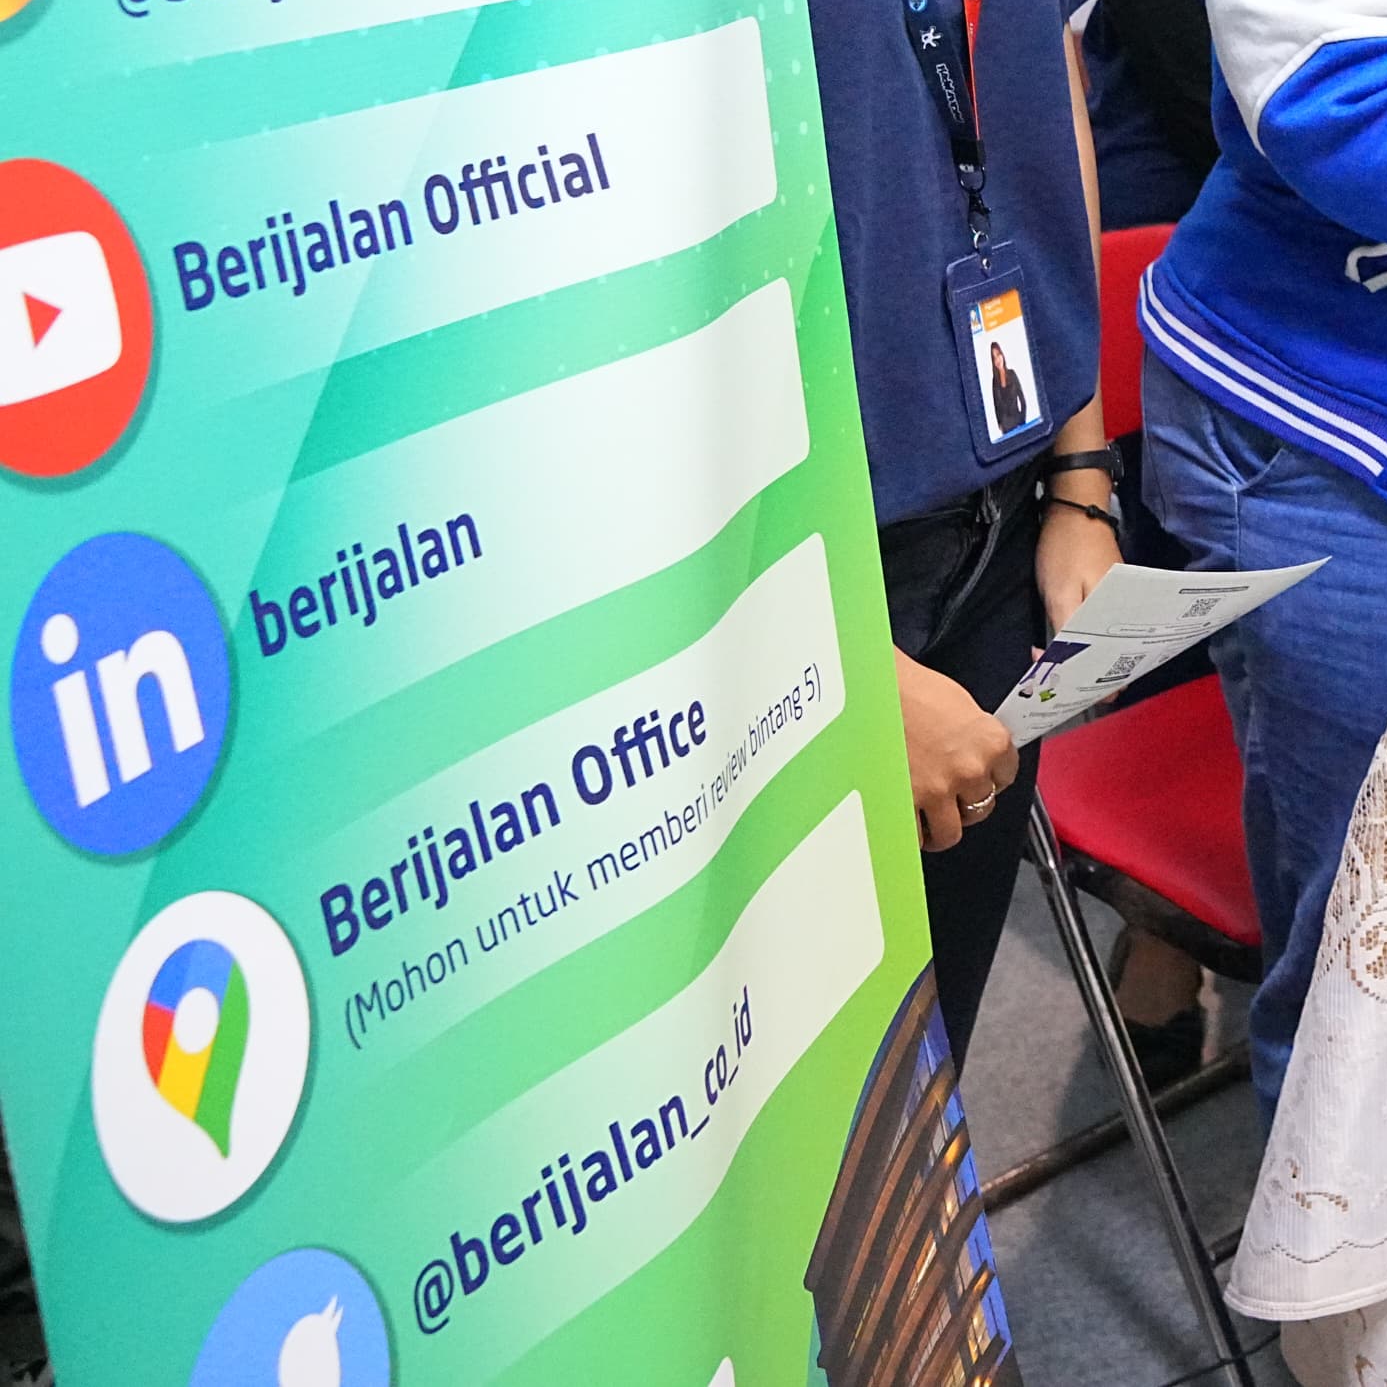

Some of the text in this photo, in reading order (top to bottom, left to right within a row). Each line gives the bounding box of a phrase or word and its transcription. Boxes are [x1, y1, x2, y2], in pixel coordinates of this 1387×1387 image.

[173, 132, 611, 312] Berijalan Official
[250, 510, 484, 658] berijalan
[319, 699, 707, 958] Berijalan Office
[345, 662, 823, 1050] (Mohon untuk memberi review bintang 5)
[412, 985, 754, 1336] @berijalan_co_id
